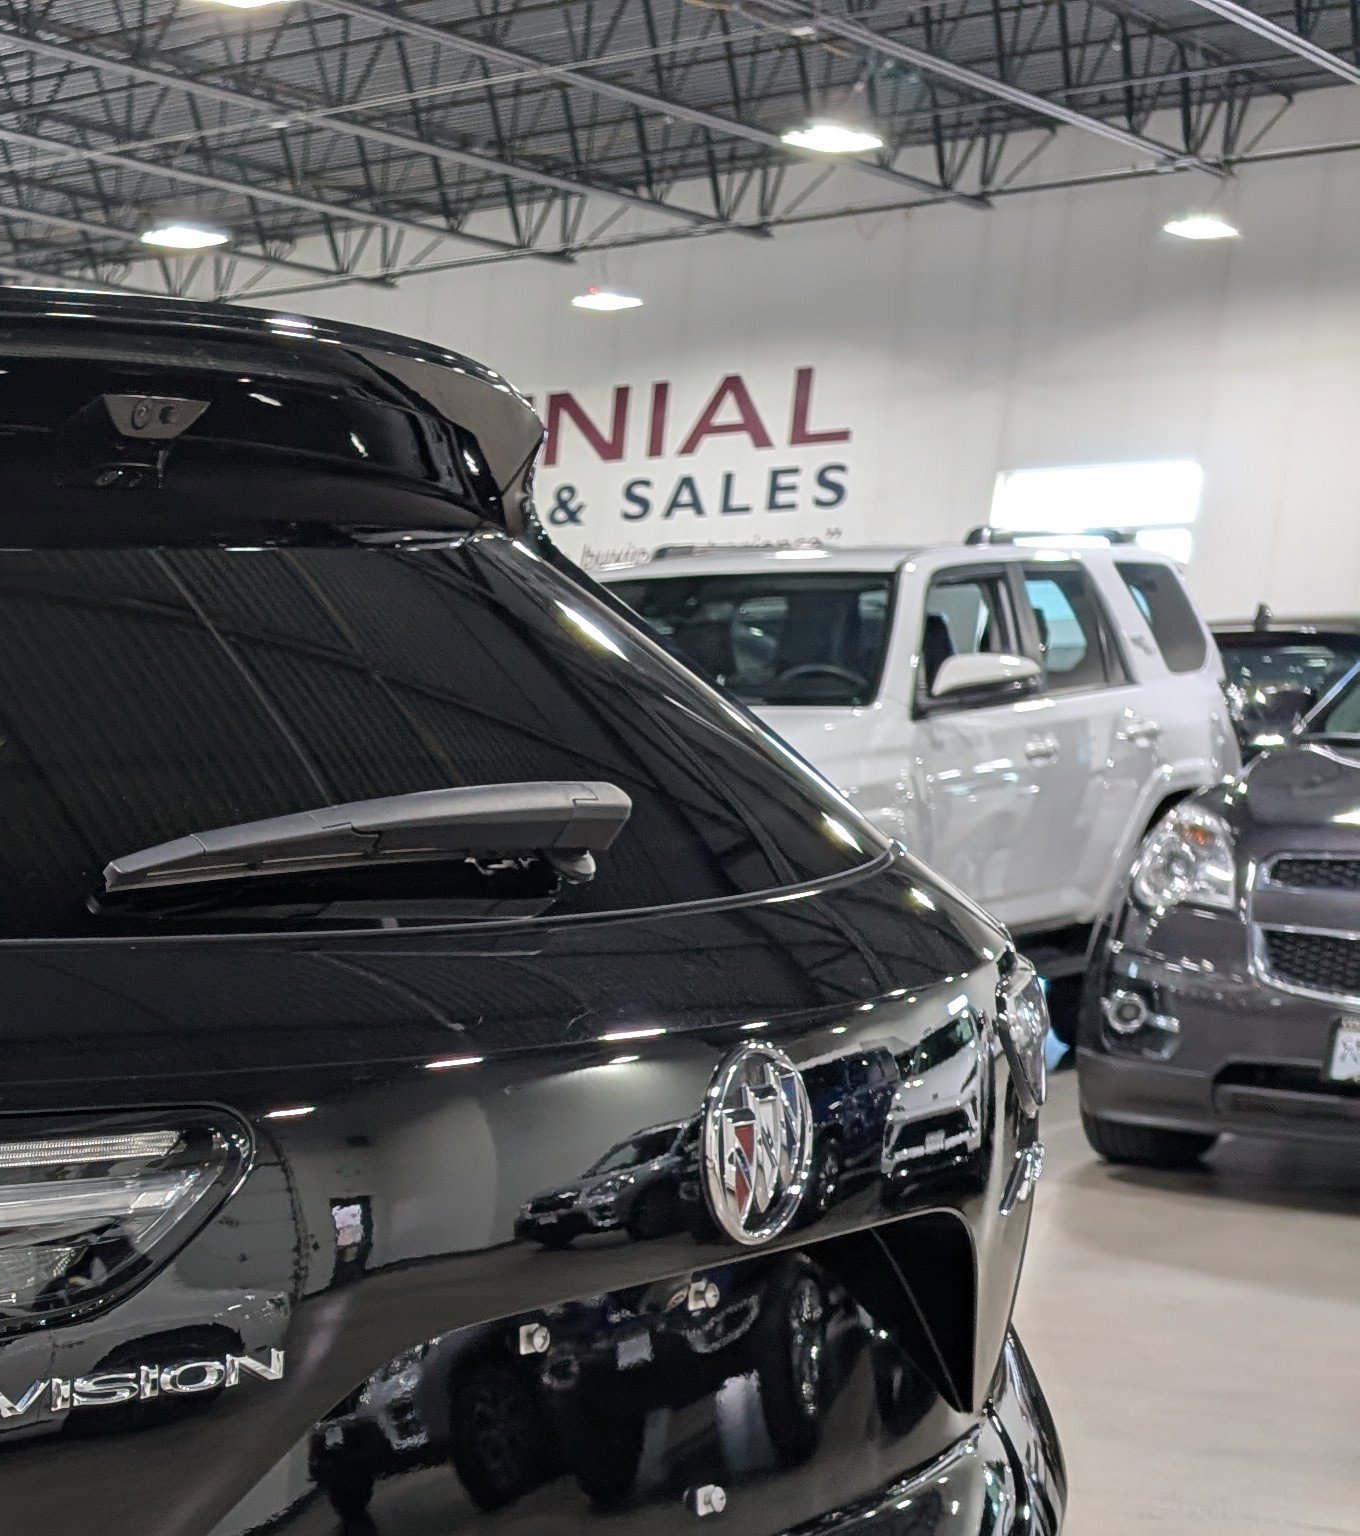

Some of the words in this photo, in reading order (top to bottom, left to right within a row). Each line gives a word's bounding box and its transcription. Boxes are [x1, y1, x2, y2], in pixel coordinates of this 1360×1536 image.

[522, 366, 853, 466] NIAL
[548, 485, 585, 526] &
[621, 463, 850, 520] SALES
